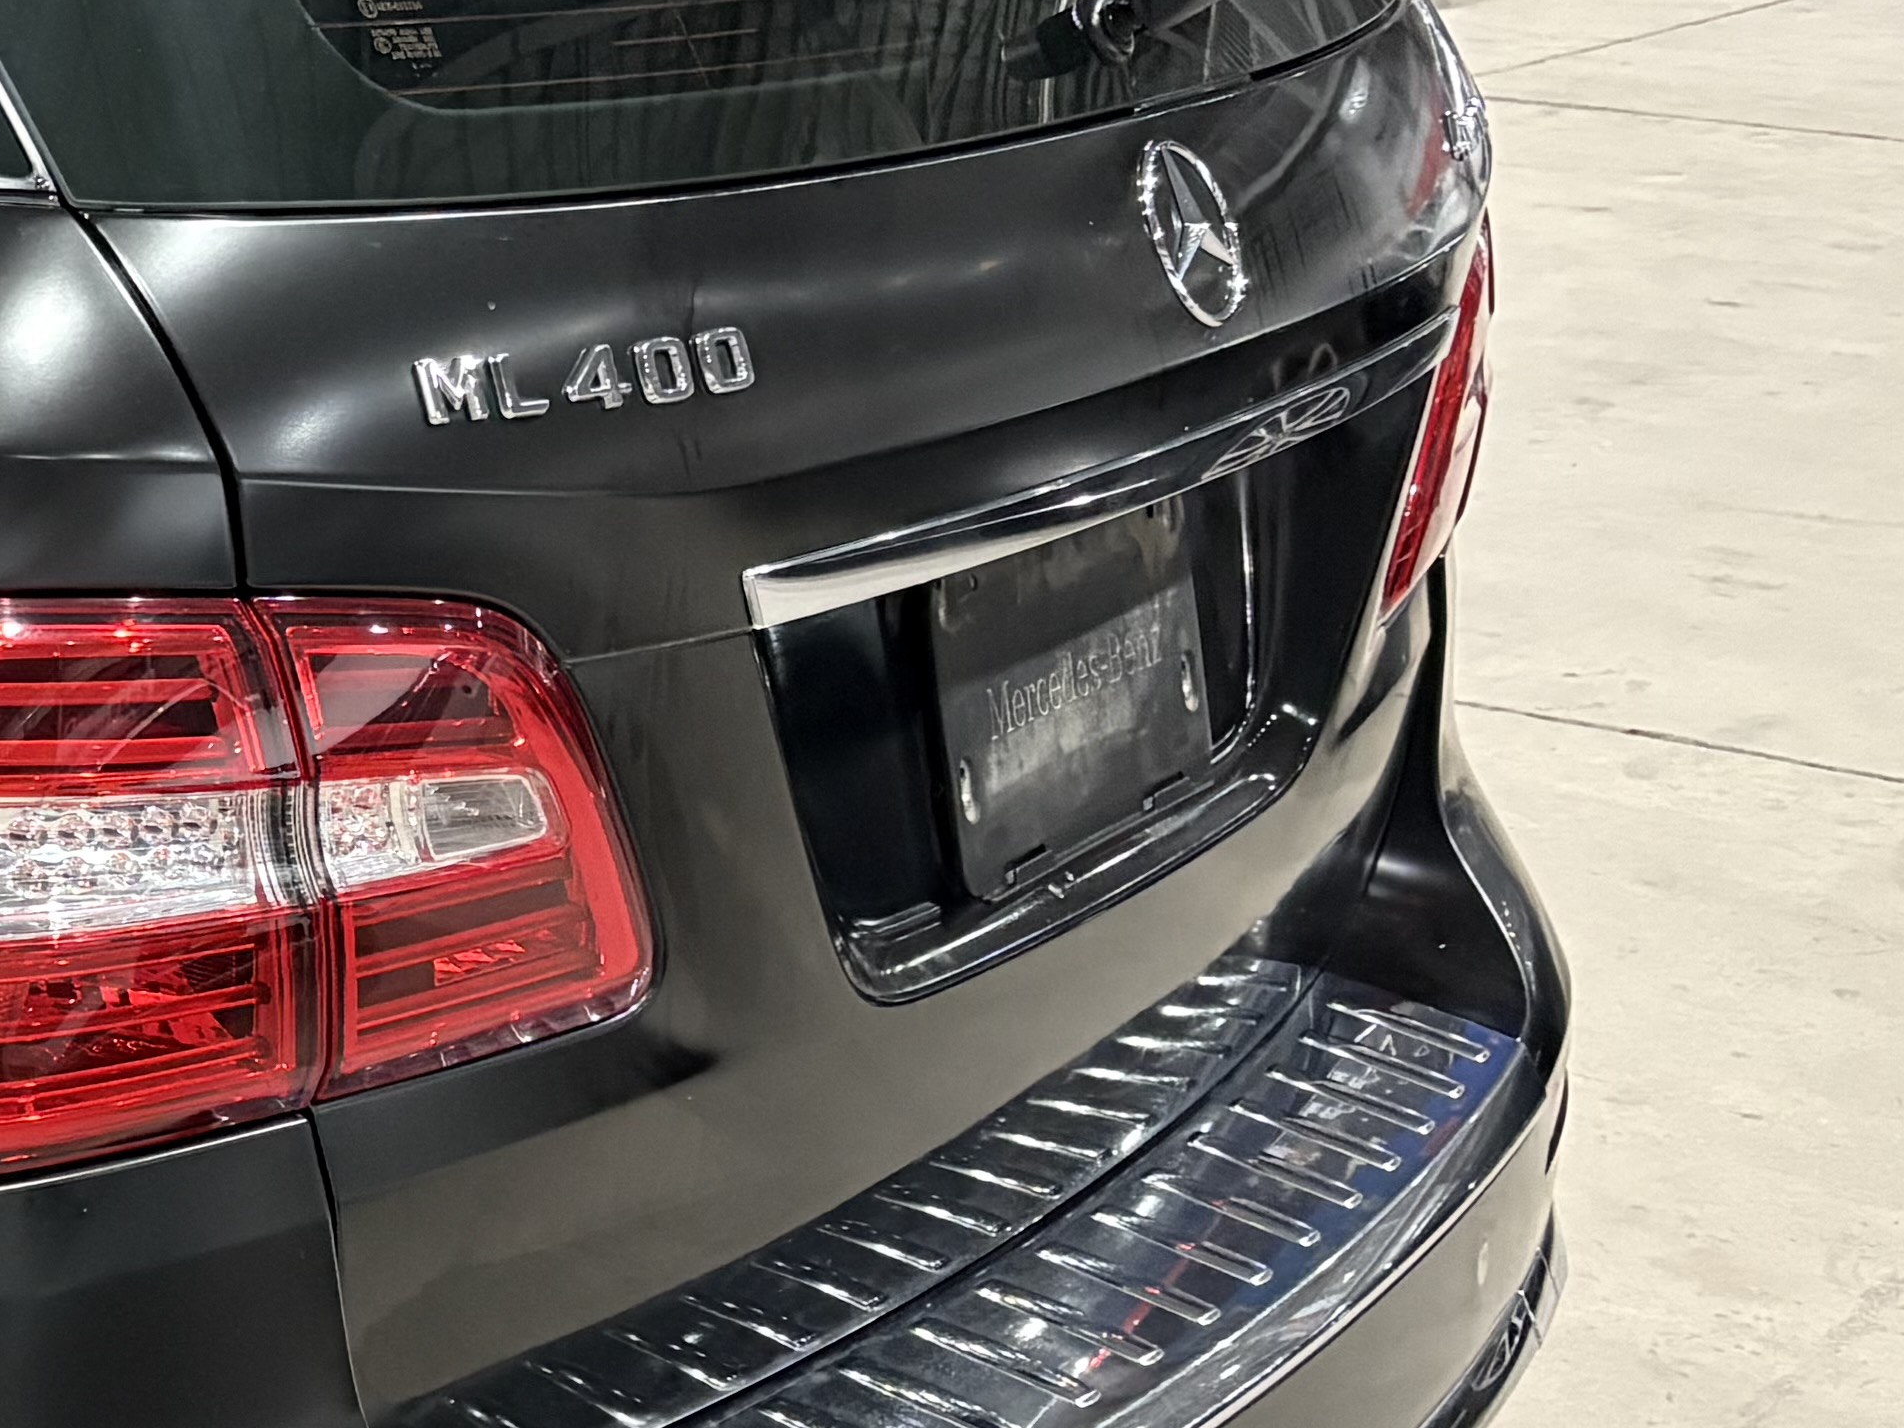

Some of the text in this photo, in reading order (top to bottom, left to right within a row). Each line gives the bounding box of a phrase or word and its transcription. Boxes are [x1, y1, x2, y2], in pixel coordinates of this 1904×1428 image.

[411, 326, 756, 425] ML 400
[986, 624, 1163, 740] Mercedes-Benz
